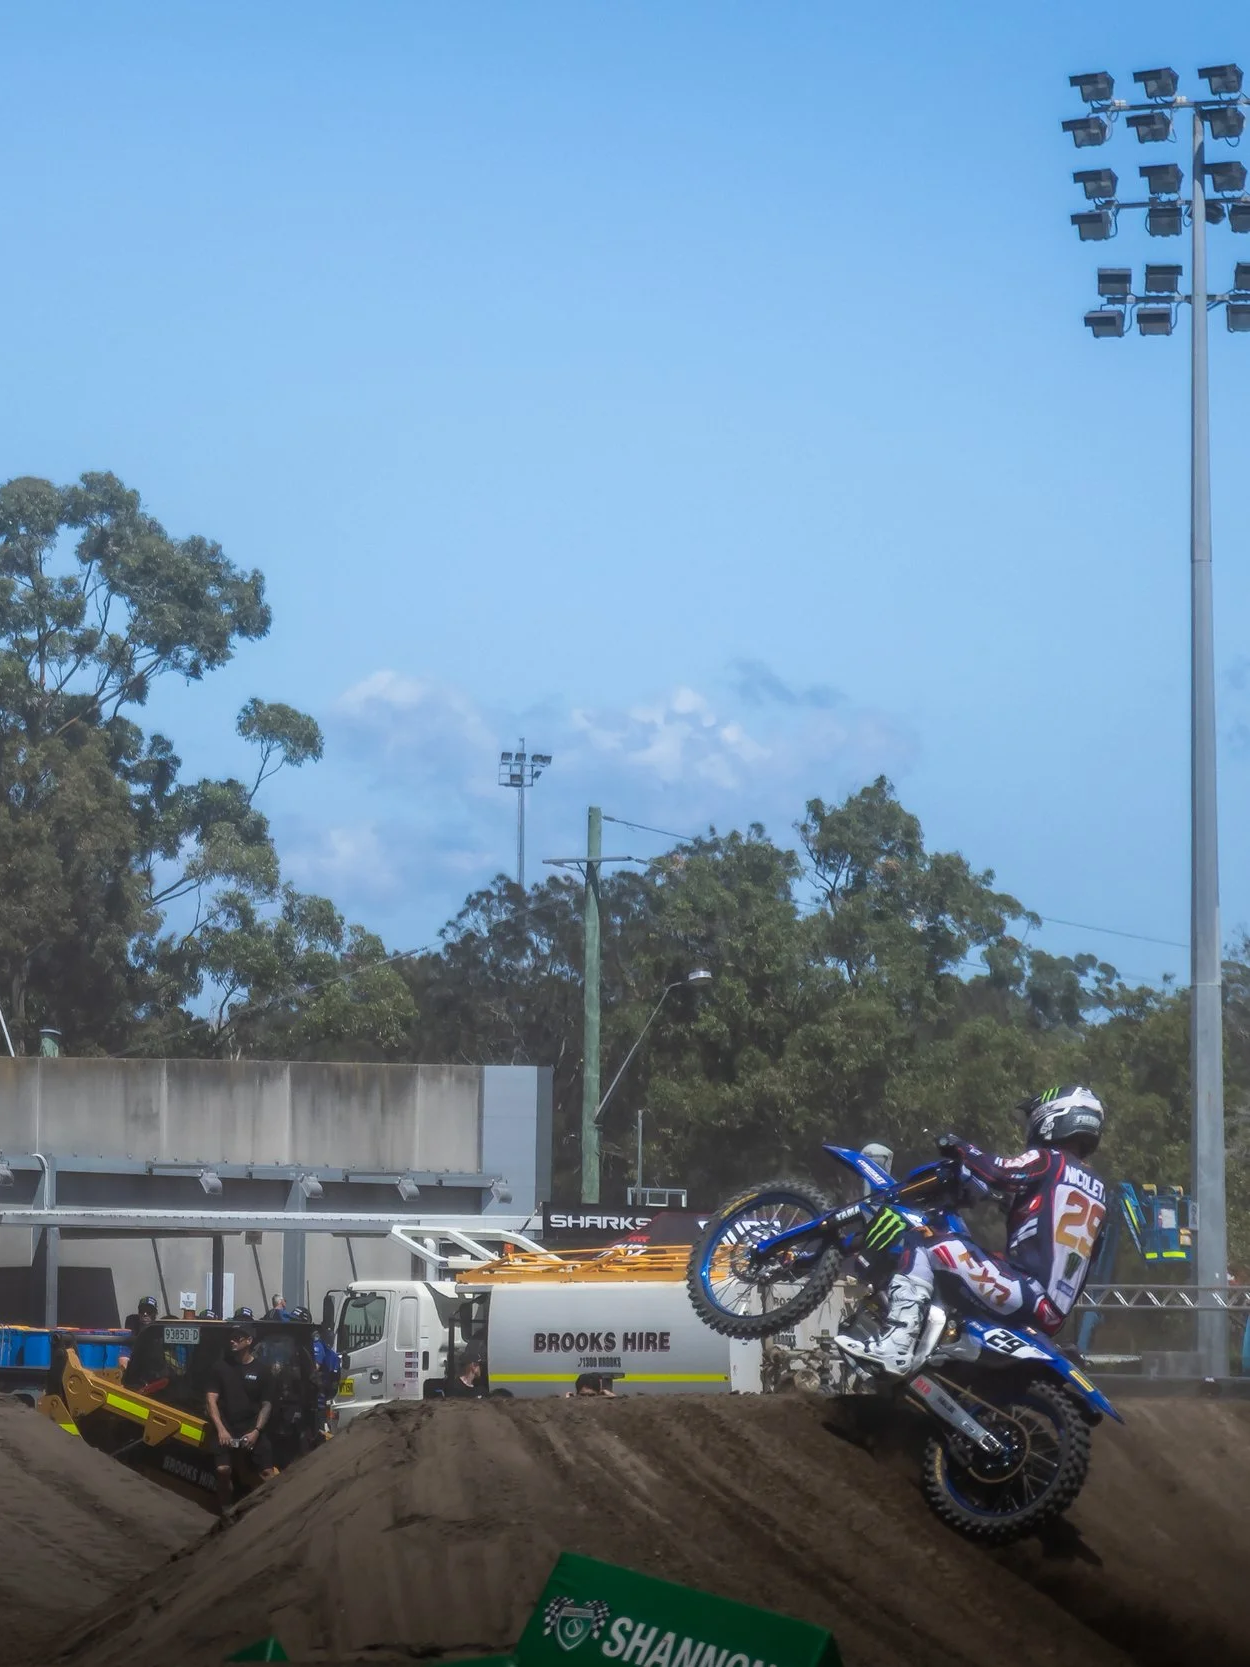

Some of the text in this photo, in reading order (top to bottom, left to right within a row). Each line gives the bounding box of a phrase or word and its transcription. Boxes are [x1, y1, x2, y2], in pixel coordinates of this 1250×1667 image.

[1063, 1165, 1106, 1203] NICOLET
[550, 1214, 652, 1230] SHARKS
[1056, 1190, 1106, 1258] 29
[533, 1332, 671, 1353] BROOKS HIRE
[986, 1328, 1030, 1354] 29
[602, 1616, 778, 1667] SHANN
